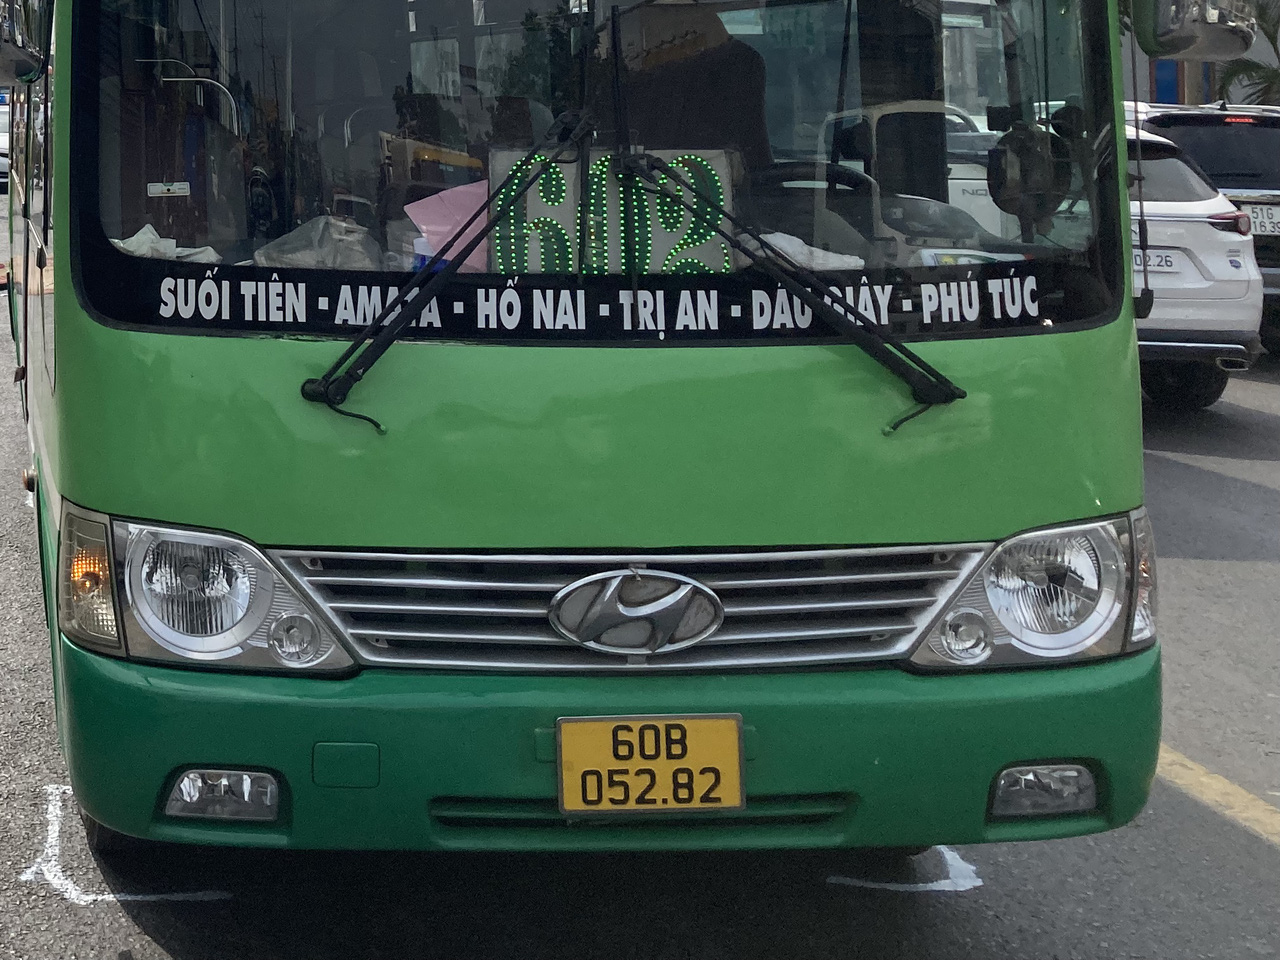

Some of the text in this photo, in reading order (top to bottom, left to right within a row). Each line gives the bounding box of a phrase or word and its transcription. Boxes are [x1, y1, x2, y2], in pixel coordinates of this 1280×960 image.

[1251, 207, 1274, 220] 51G
[159, 267, 230, 320] SUỐI
[240, 272, 306, 323] TIÊN
[477, 275, 521, 330] HỐ
[532, 289, 586, 330] NAI
[618, 290, 665, 340] TRỊ
[675, 289, 719, 330] AN
[921, 271, 980, 324] PHÚ
[987, 268, 1039, 319] TÚC
[612, 723, 688, 761] 60B
[581, 766, 722, 806] 052.82
